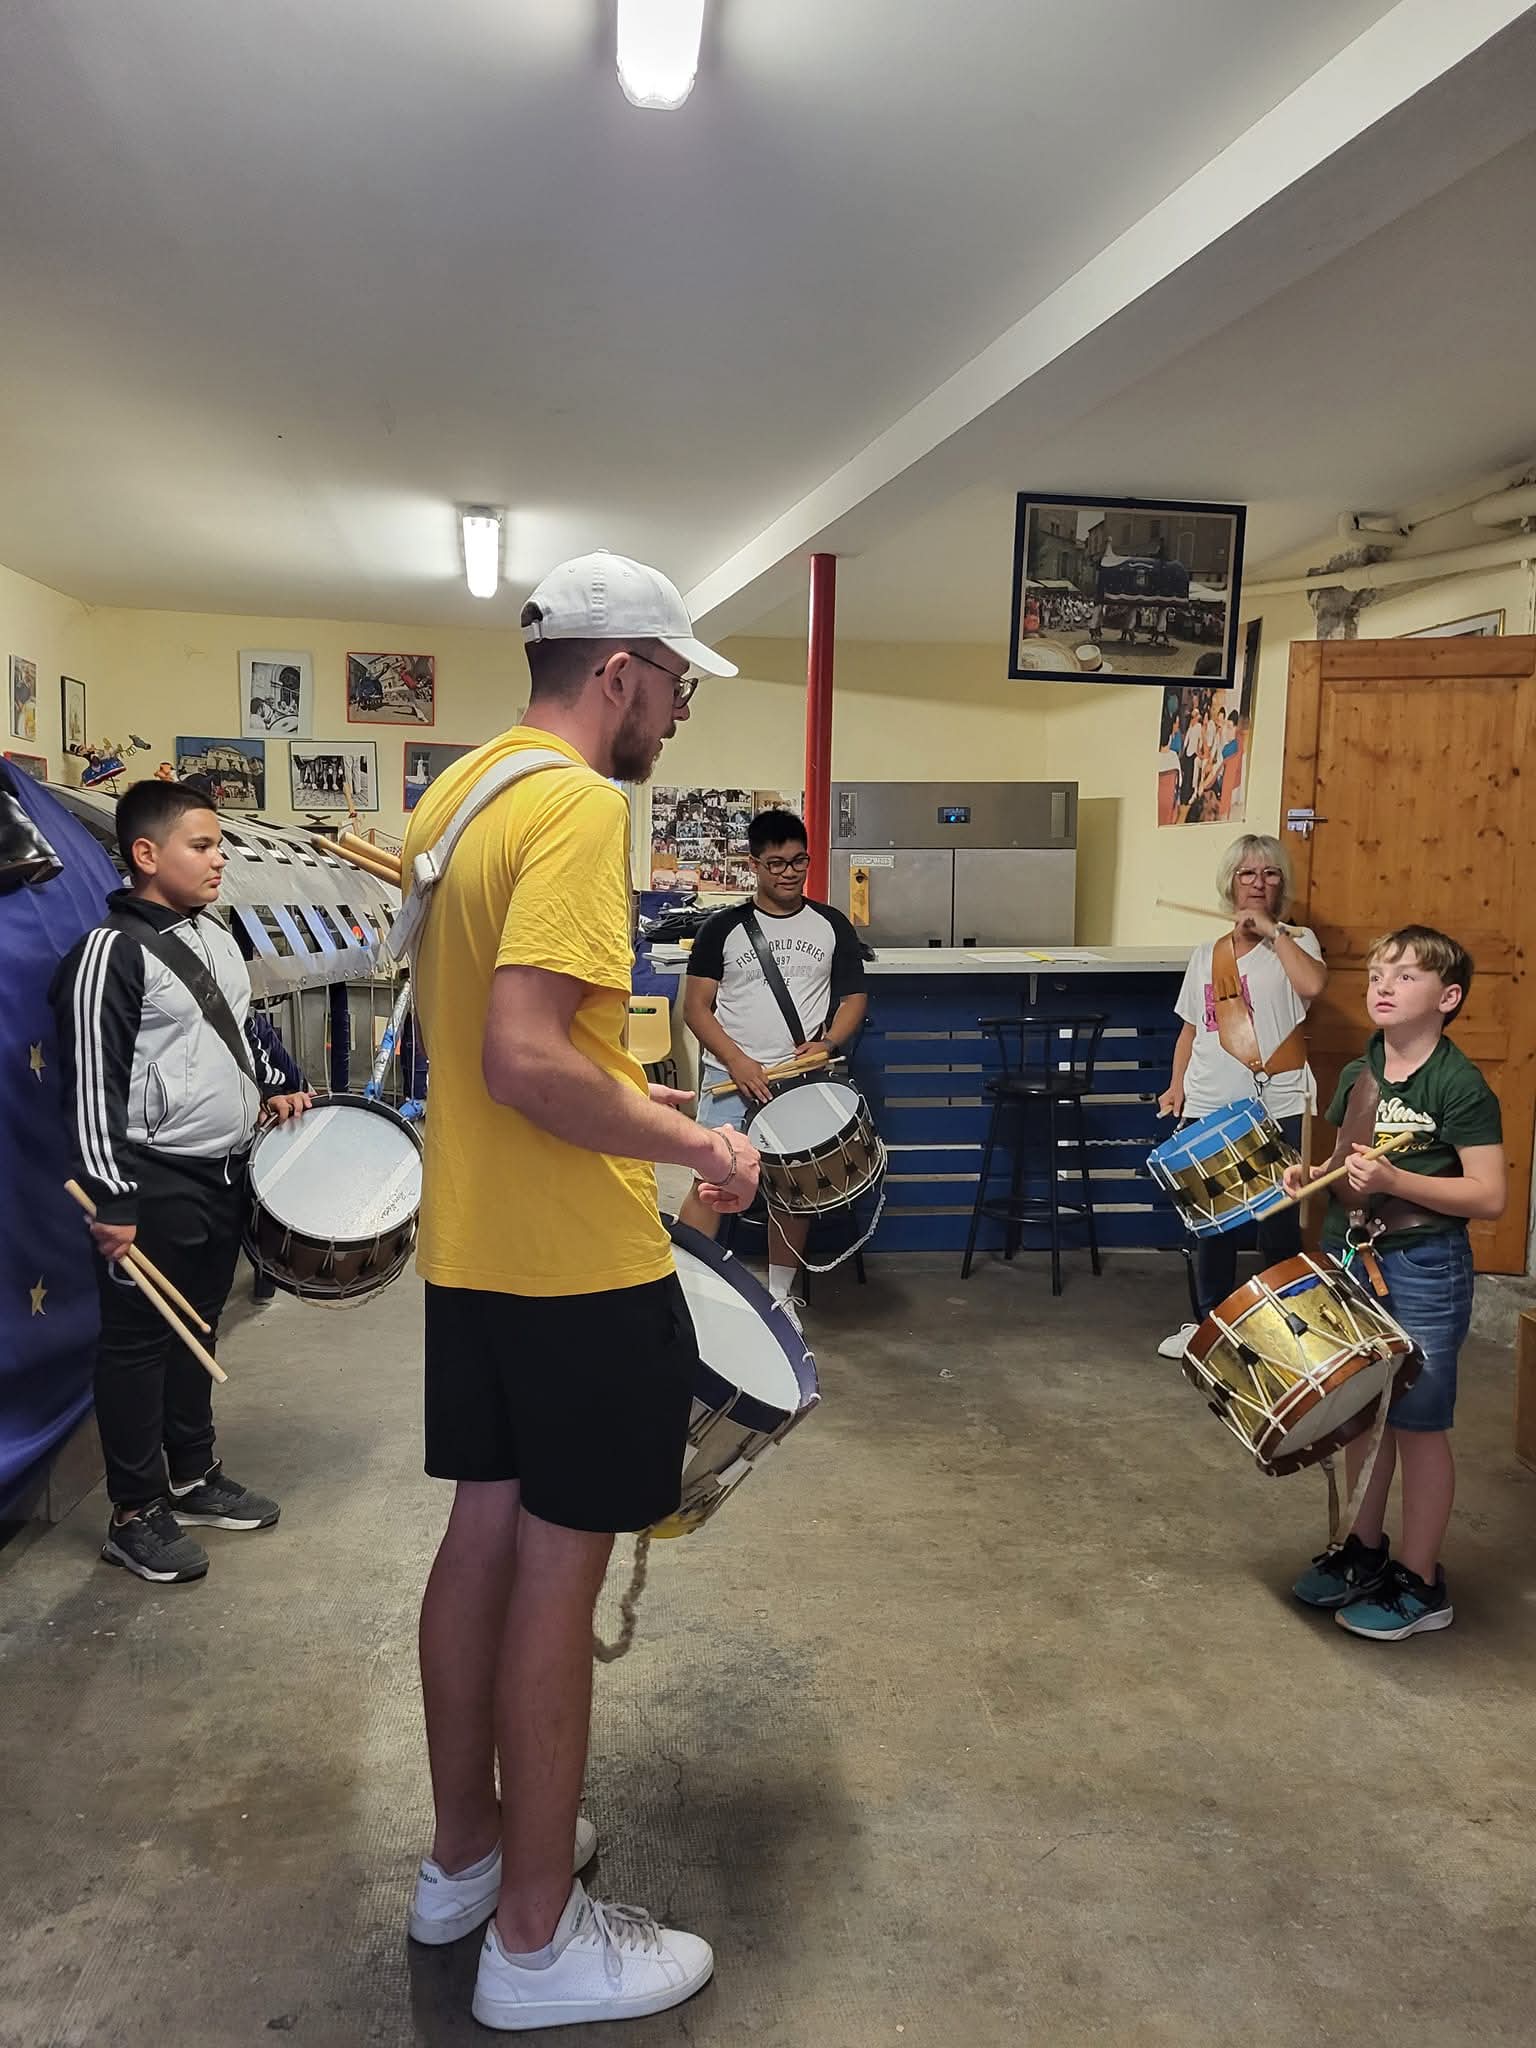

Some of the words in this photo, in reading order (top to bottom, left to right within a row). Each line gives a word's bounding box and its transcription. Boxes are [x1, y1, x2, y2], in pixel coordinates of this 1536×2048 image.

[736, 949, 757, 969] FISE
[768, 938, 793, 953] ORLD
[795, 939, 825, 963] SERIES
[775, 955, 791, 966] 997
